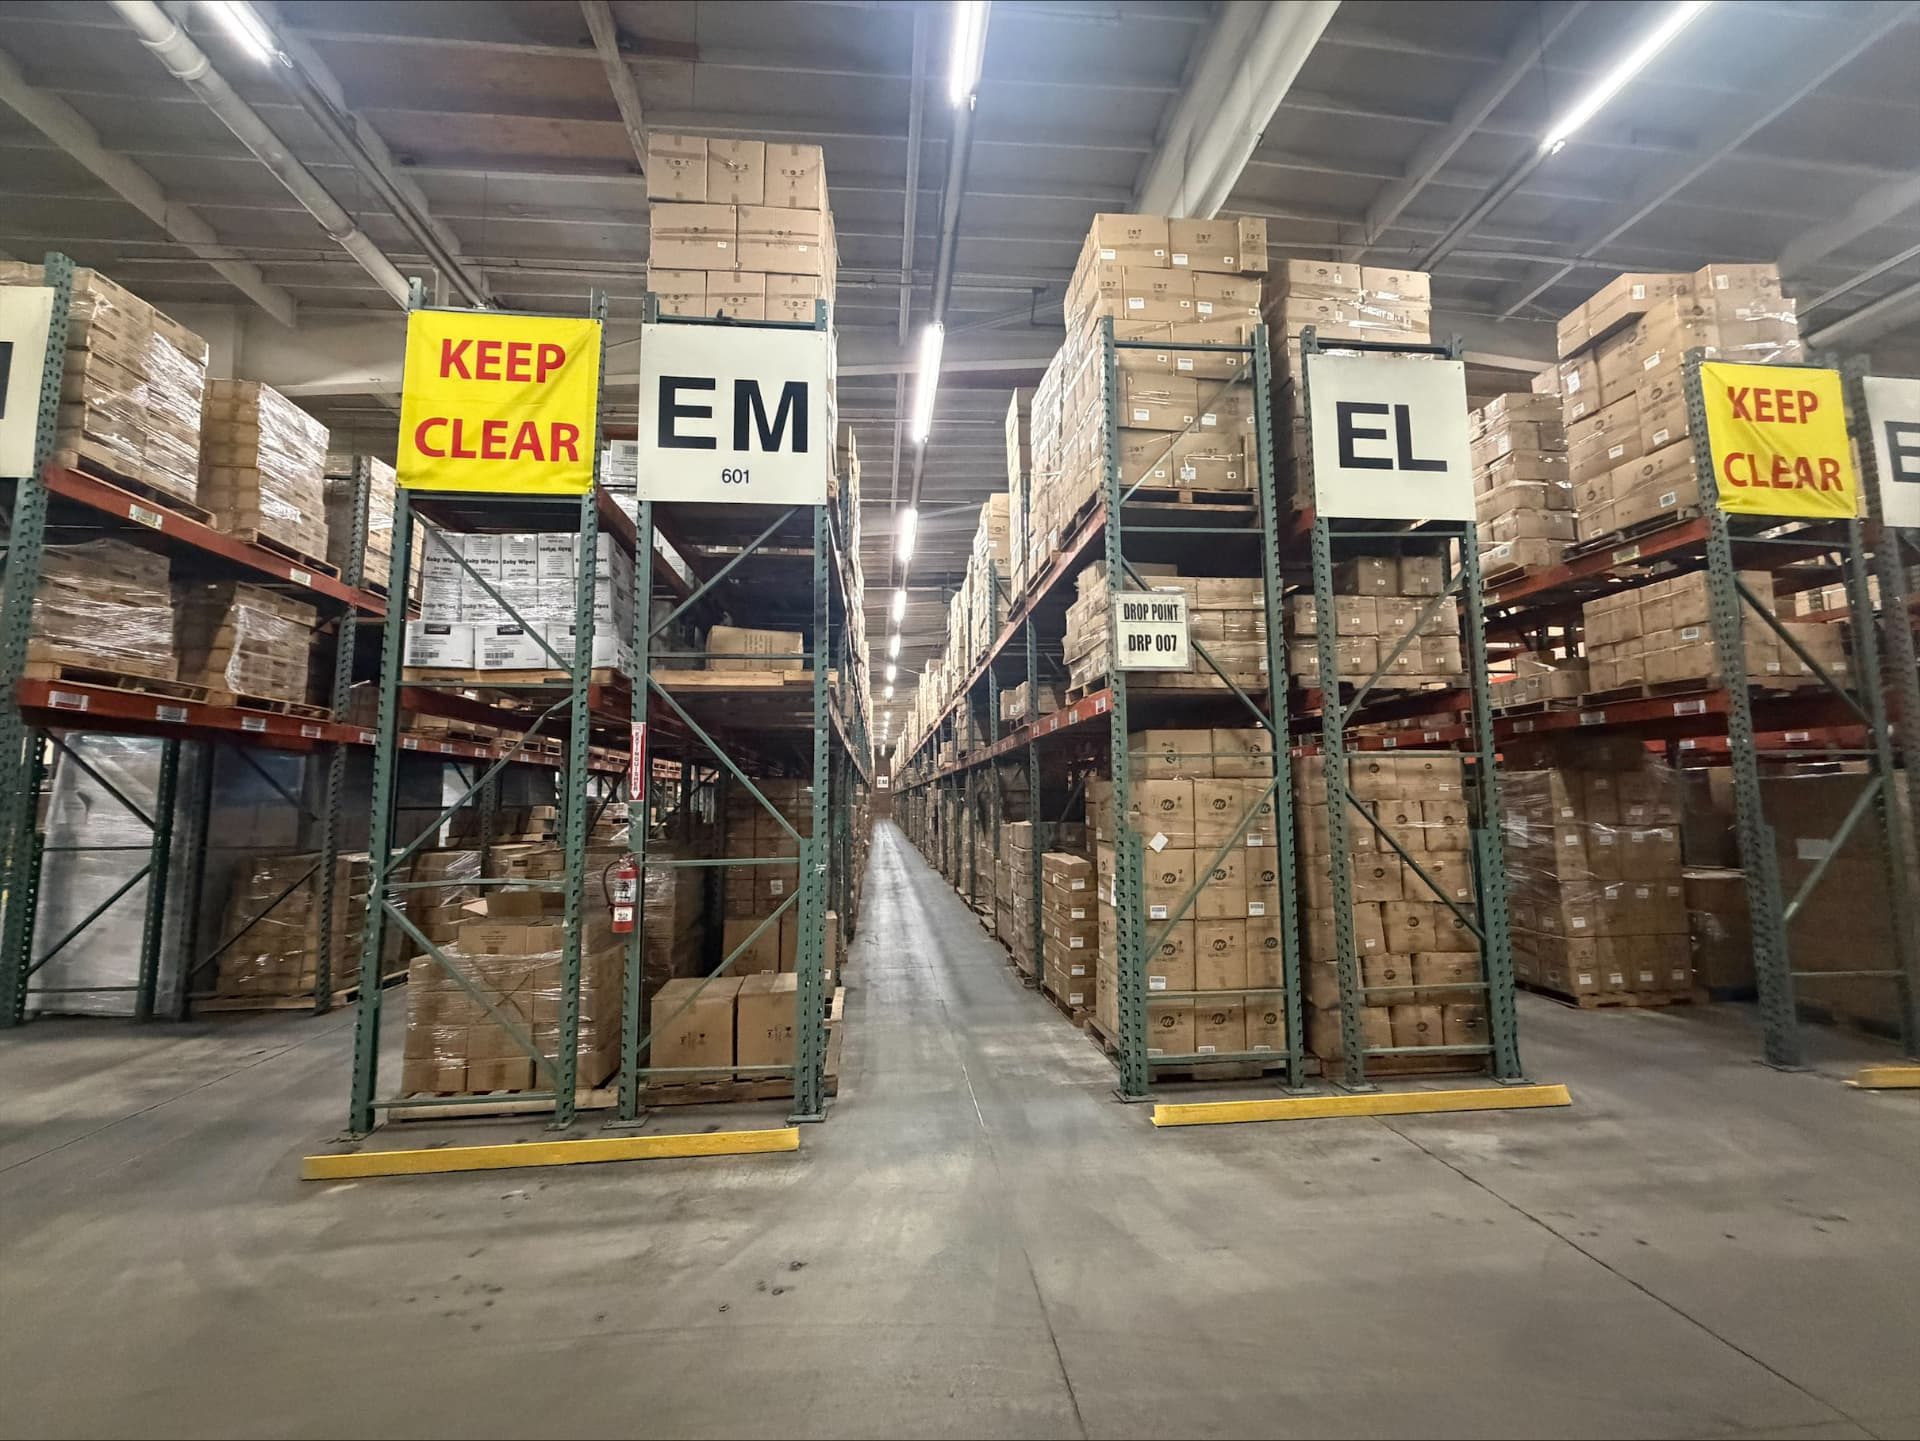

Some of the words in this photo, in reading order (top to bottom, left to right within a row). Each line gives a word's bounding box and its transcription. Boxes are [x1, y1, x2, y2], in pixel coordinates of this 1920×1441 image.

[440, 338, 566, 384] KEEP
[658, 376, 808, 453] EM
[1727, 386, 1818, 424] KEEP
[415, 417, 579, 462] CLEAR
[1336, 401, 1448, 472] EL
[721, 468, 750, 484] 601
[1723, 452, 1843, 491] CLEAR
[426, 556, 441, 564] Baby
[1123, 603, 1149, 620] DROP
[1151, 604, 1178, 621] POINT
[1128, 634, 1152, 652] DRP
[1155, 634, 1177, 652] 007
